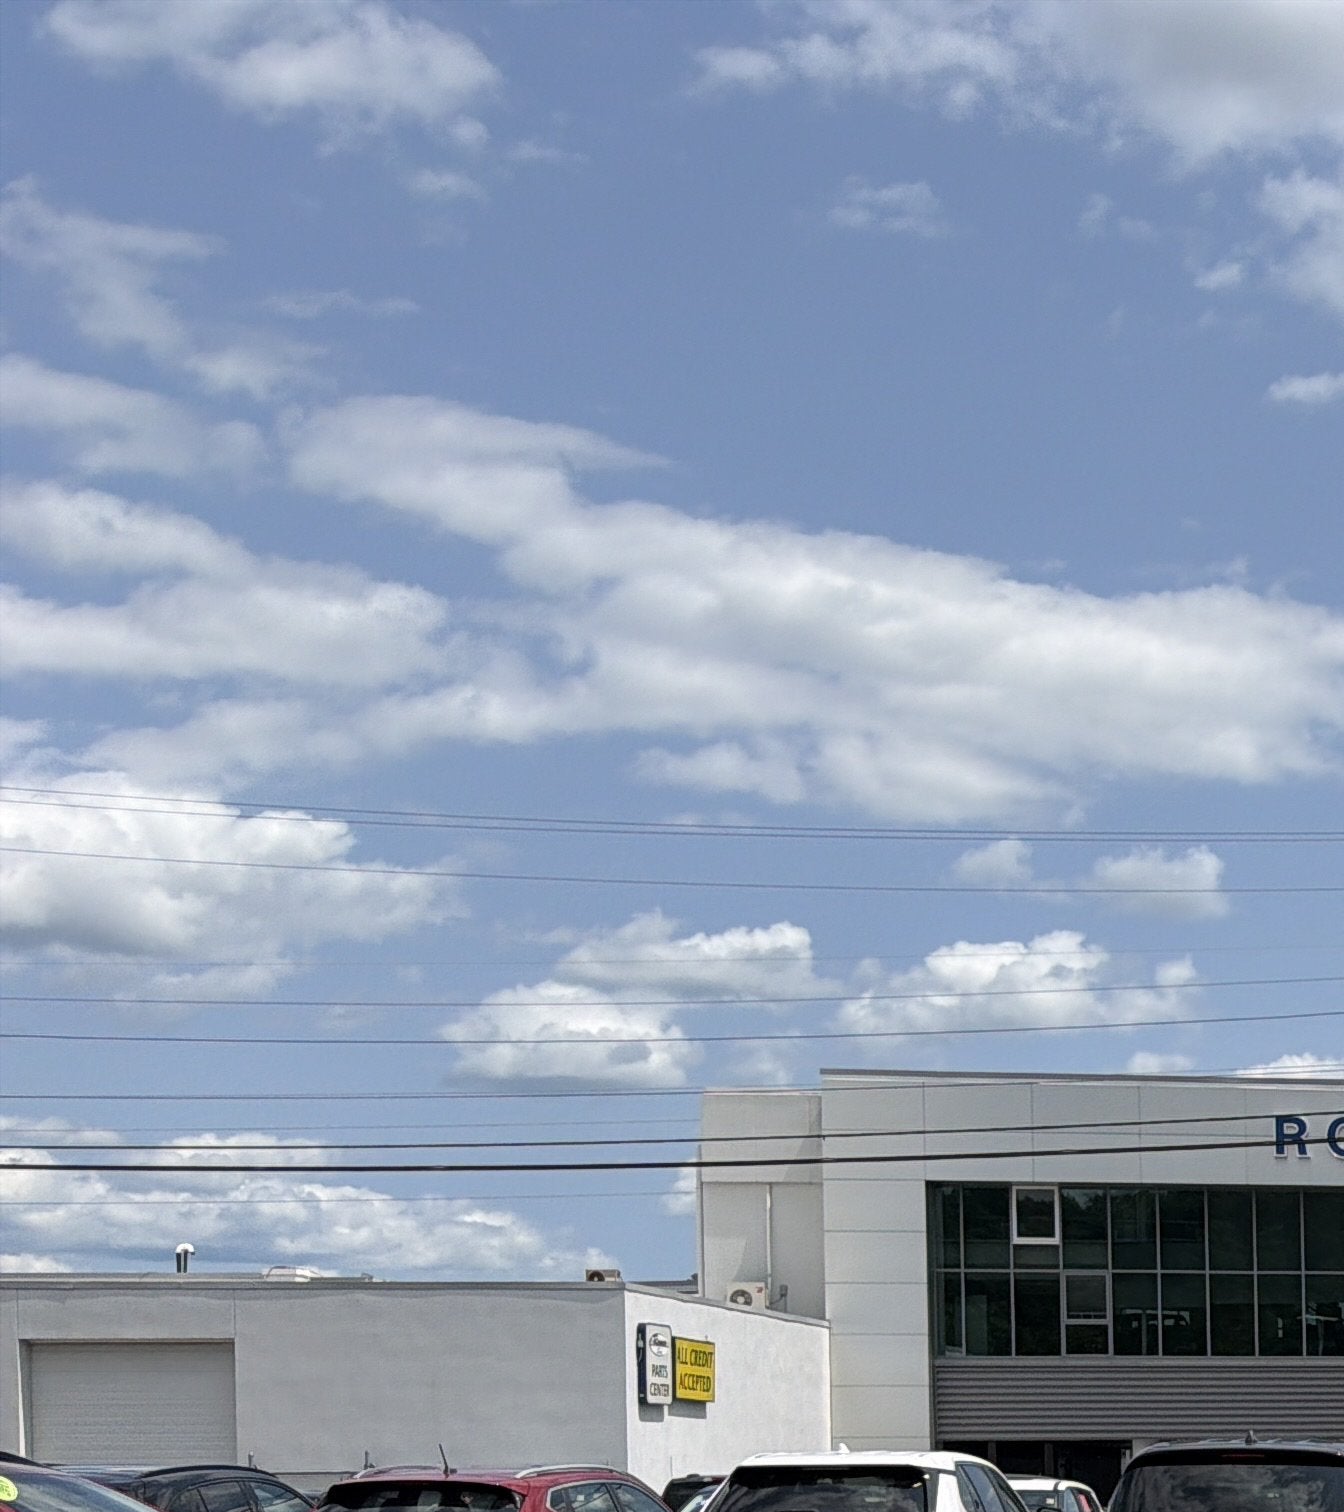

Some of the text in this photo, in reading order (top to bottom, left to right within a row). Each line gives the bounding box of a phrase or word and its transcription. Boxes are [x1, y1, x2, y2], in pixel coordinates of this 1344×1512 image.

[678, 1346, 714, 1369] ALL CREDIT
[651, 1364, 669, 1379] PARTS
[649, 1383, 670, 1397] CENTER
[679, 1372, 712, 1393] ACCEPTED
